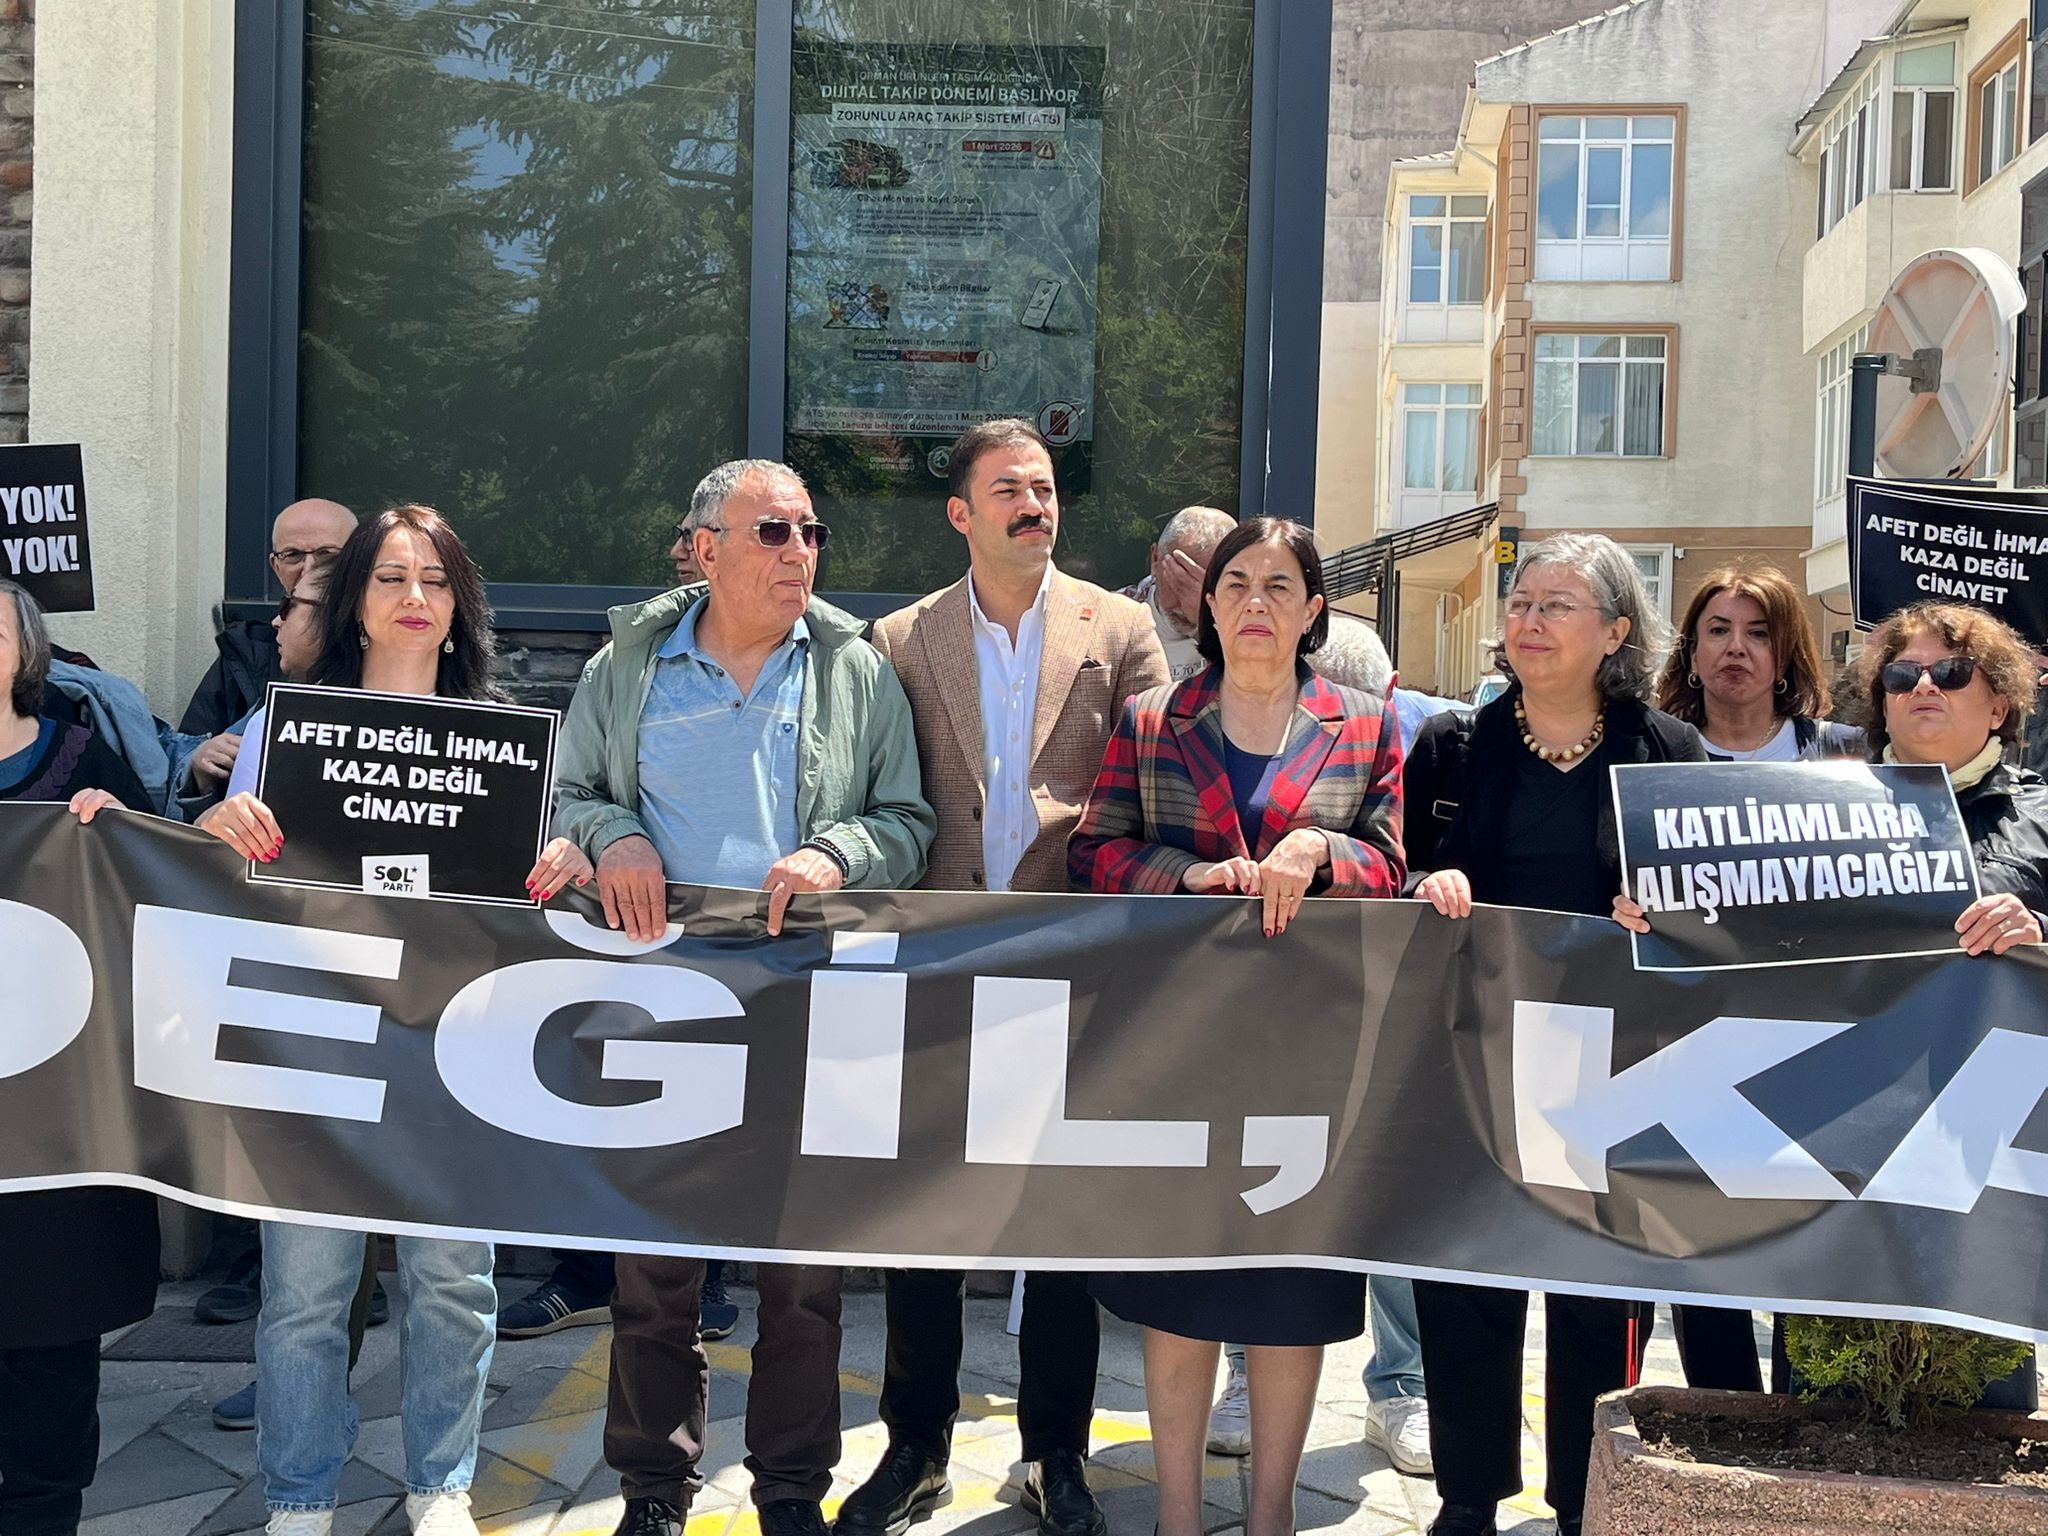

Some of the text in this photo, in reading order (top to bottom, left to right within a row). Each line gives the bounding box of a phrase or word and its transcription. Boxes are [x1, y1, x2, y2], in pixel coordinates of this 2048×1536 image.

[881, 82, 928, 99] TAKİP
[836, 110, 896, 121] ZORUNLU
[898, 111, 933, 124] ARAÇ
[935, 111, 972, 123] TAKİP
[975, 111, 1025, 125] SİSTEMİ
[1000, 142, 1022, 151] 2026
[0, 484, 77, 525] YOK!
[1866, 513, 1920, 538] AFET
[1923, 524, 1988, 550] DEĞİL
[2, 535, 80, 575] YOK!
[1900, 545, 2030, 581] KAZA DEĞİL
[1916, 572, 2008, 604] CİNAYET
[278, 720, 539, 771] AFET DEĞİL İHMAL,
[322, 758, 489, 796] KAZA DEĞİL
[342, 792, 463, 828] CİNAYET
[1653, 797, 1930, 850] KATLİAMLARA
[1636, 842, 1970, 924] ALIŞMAYACAĞIZ!
